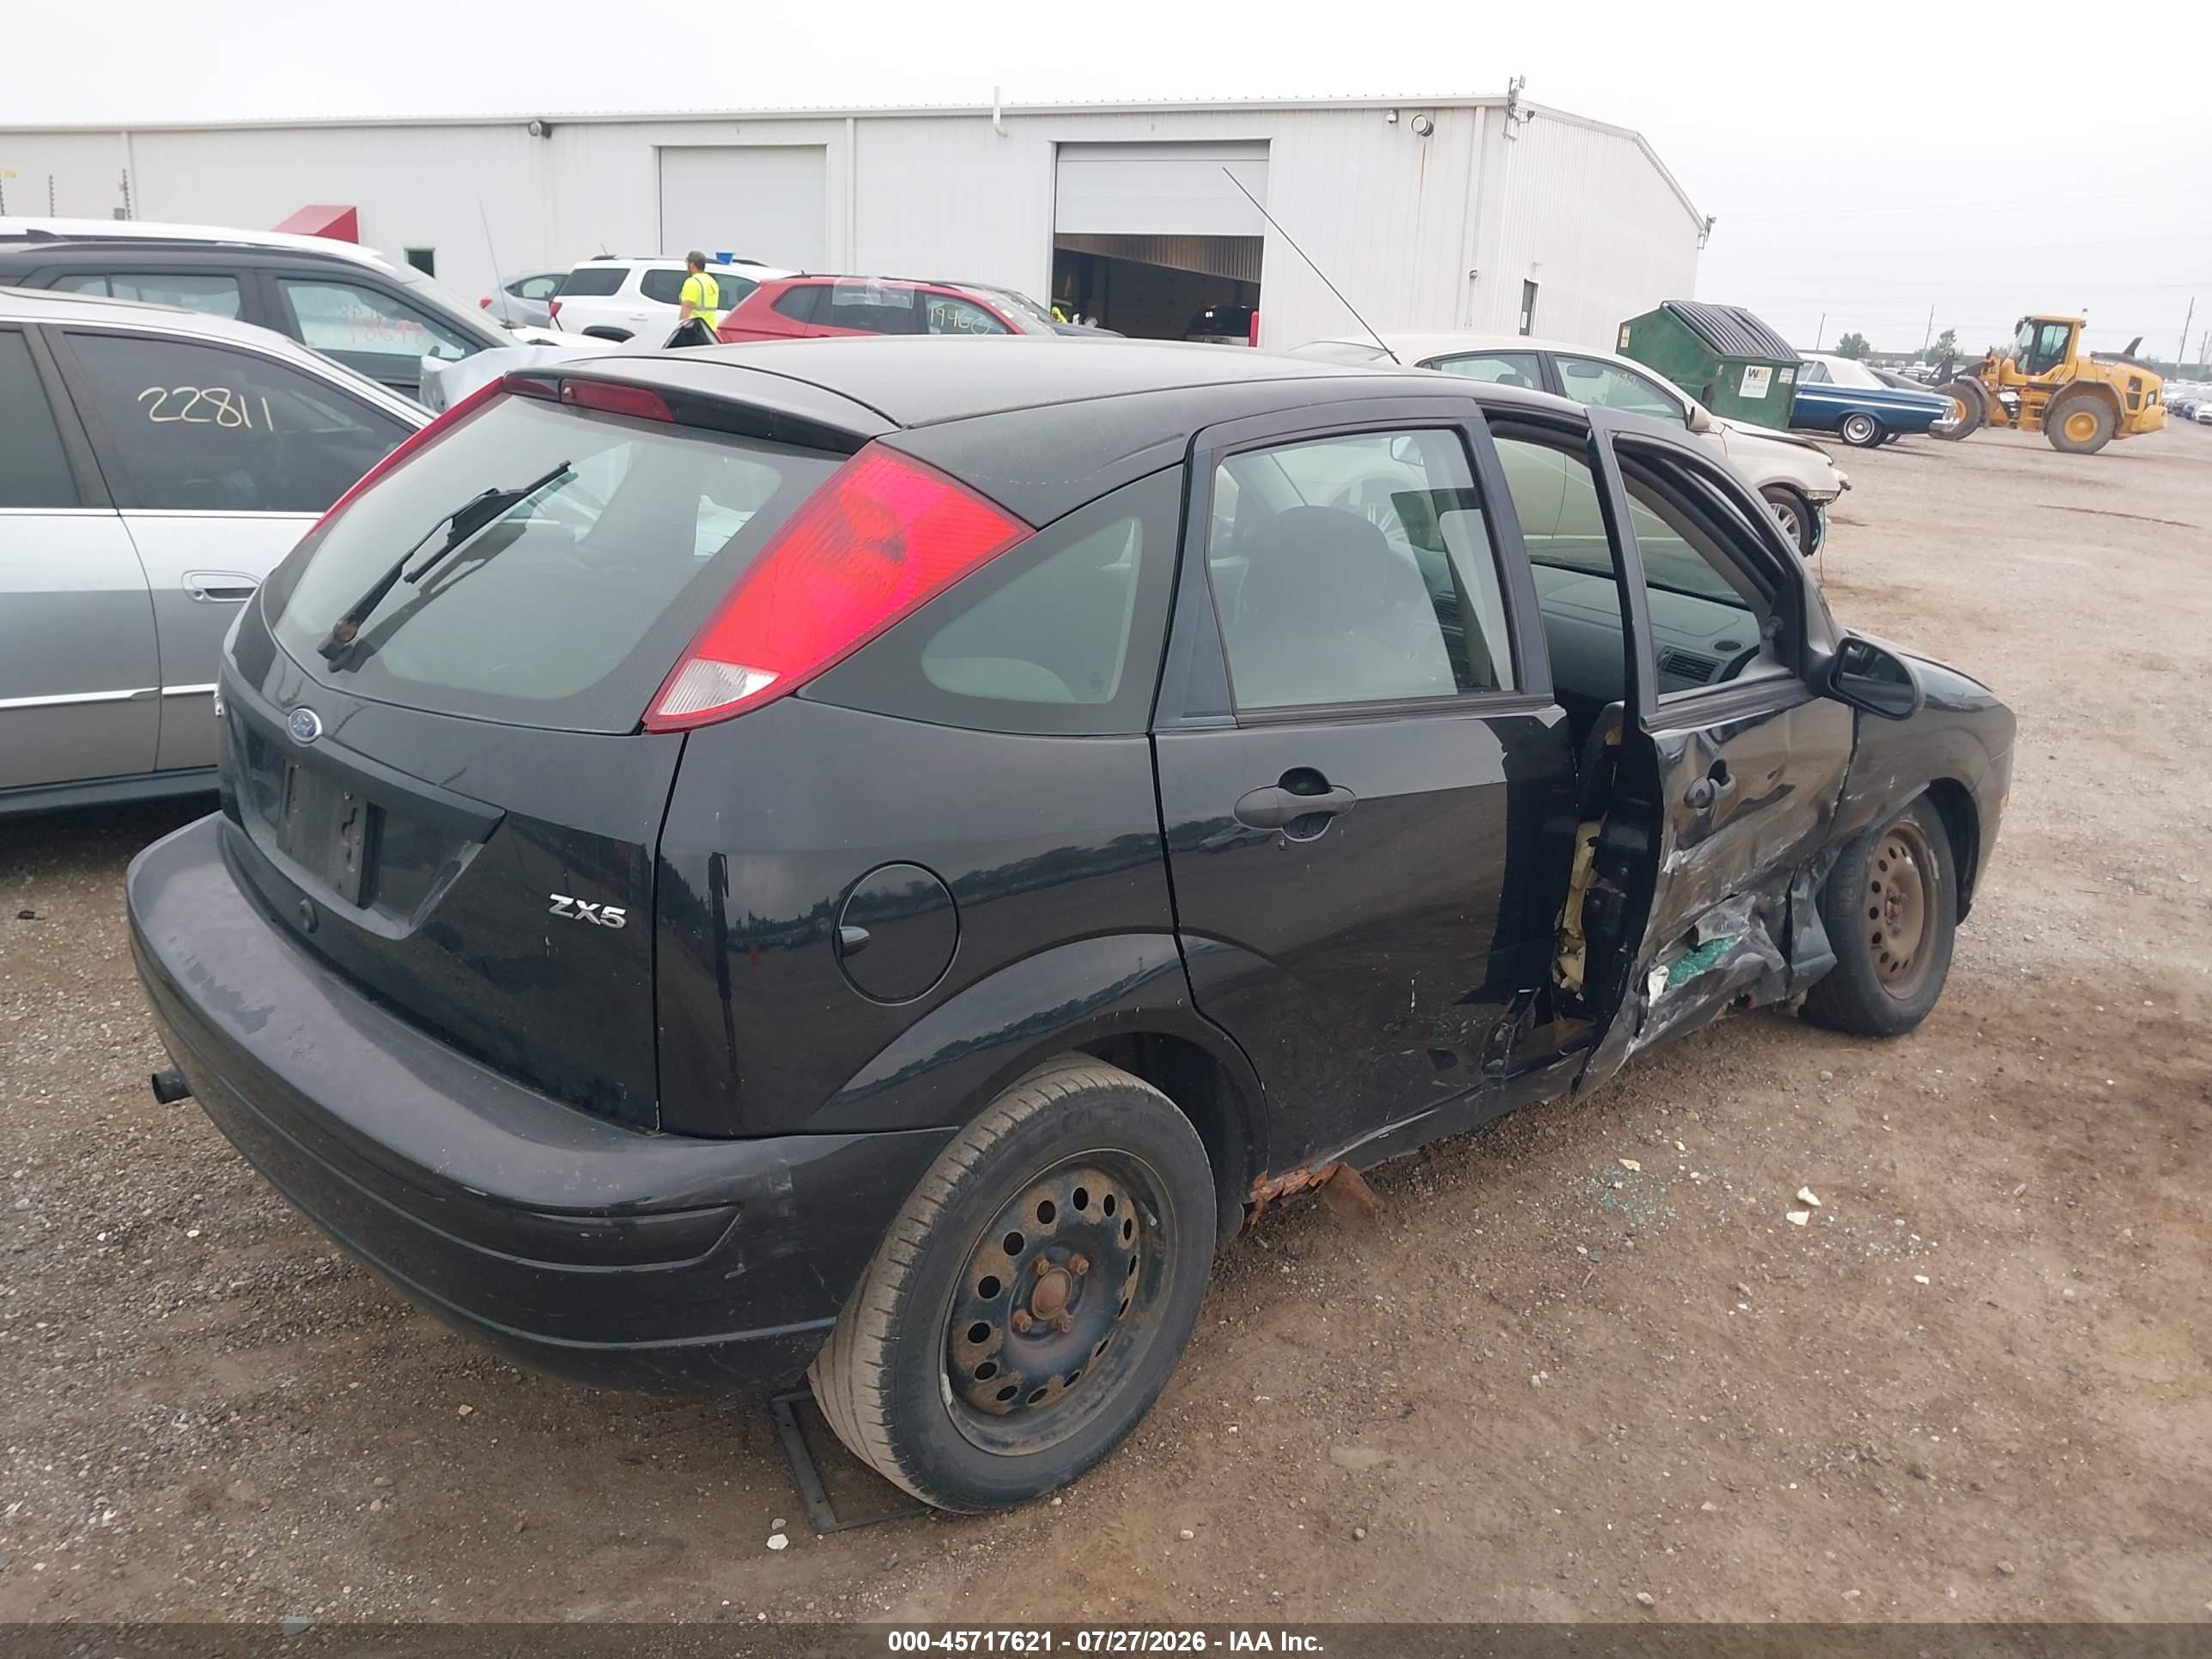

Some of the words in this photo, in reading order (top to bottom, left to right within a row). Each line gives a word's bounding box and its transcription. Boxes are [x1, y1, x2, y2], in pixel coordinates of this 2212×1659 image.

[1748, 367, 1767, 379] WM
[137, 386, 274, 433] 22811
[550, 894, 627, 929] ZX5
